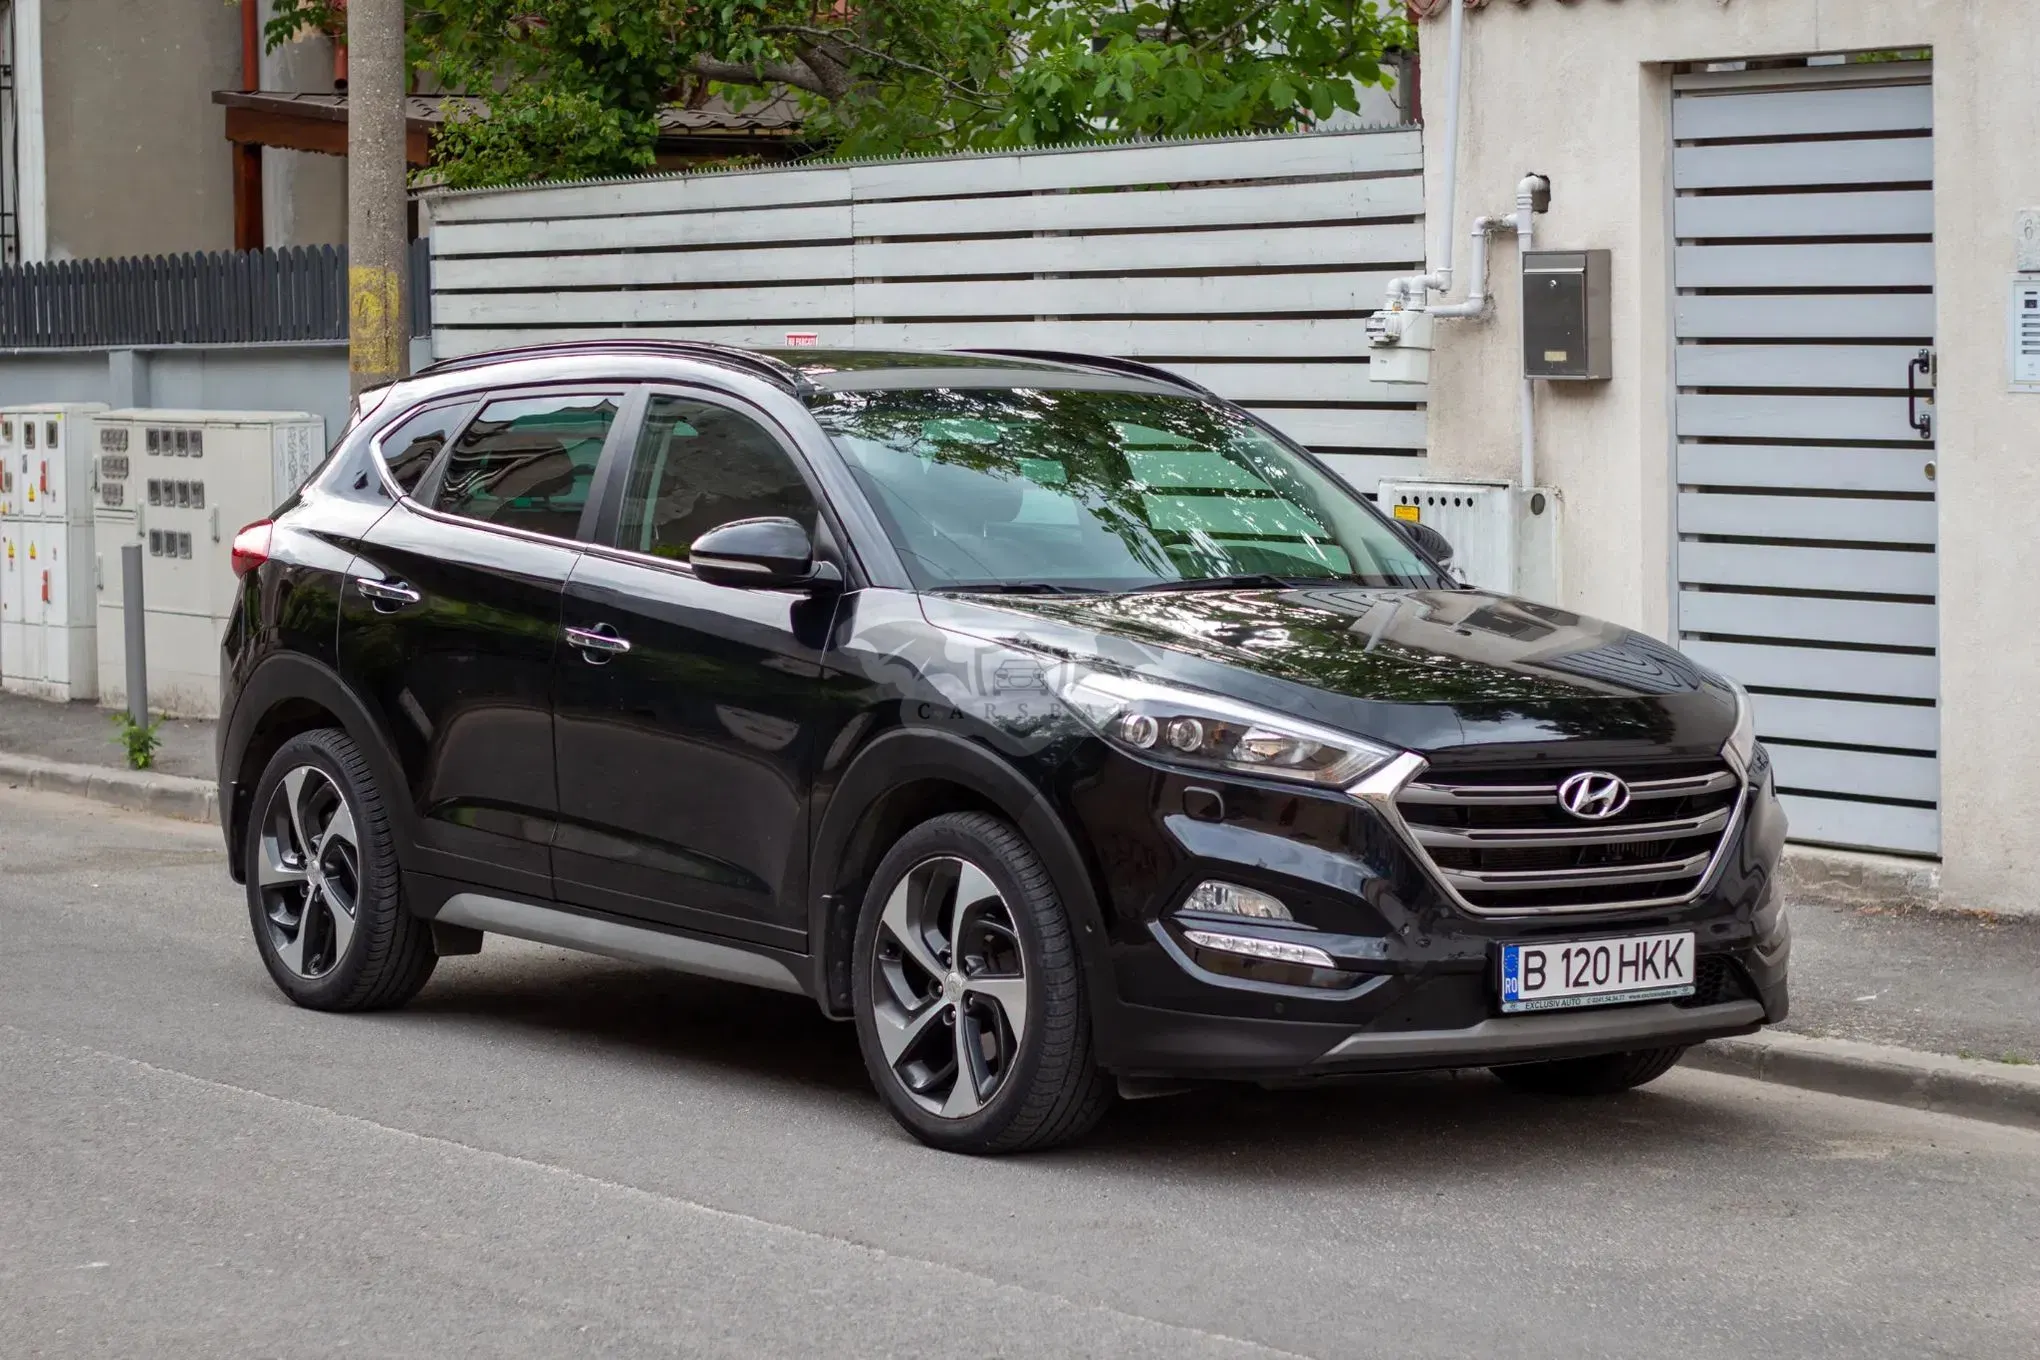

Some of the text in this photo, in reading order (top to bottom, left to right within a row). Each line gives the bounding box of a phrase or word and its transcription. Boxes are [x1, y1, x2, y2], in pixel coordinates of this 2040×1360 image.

[1524, 939, 1685, 991] B 120 HKK
[1505, 977, 1518, 994] RO
[1525, 1000, 1560, 1010] EXCLUSIV
[1561, 998, 1581, 1007] AUTO
